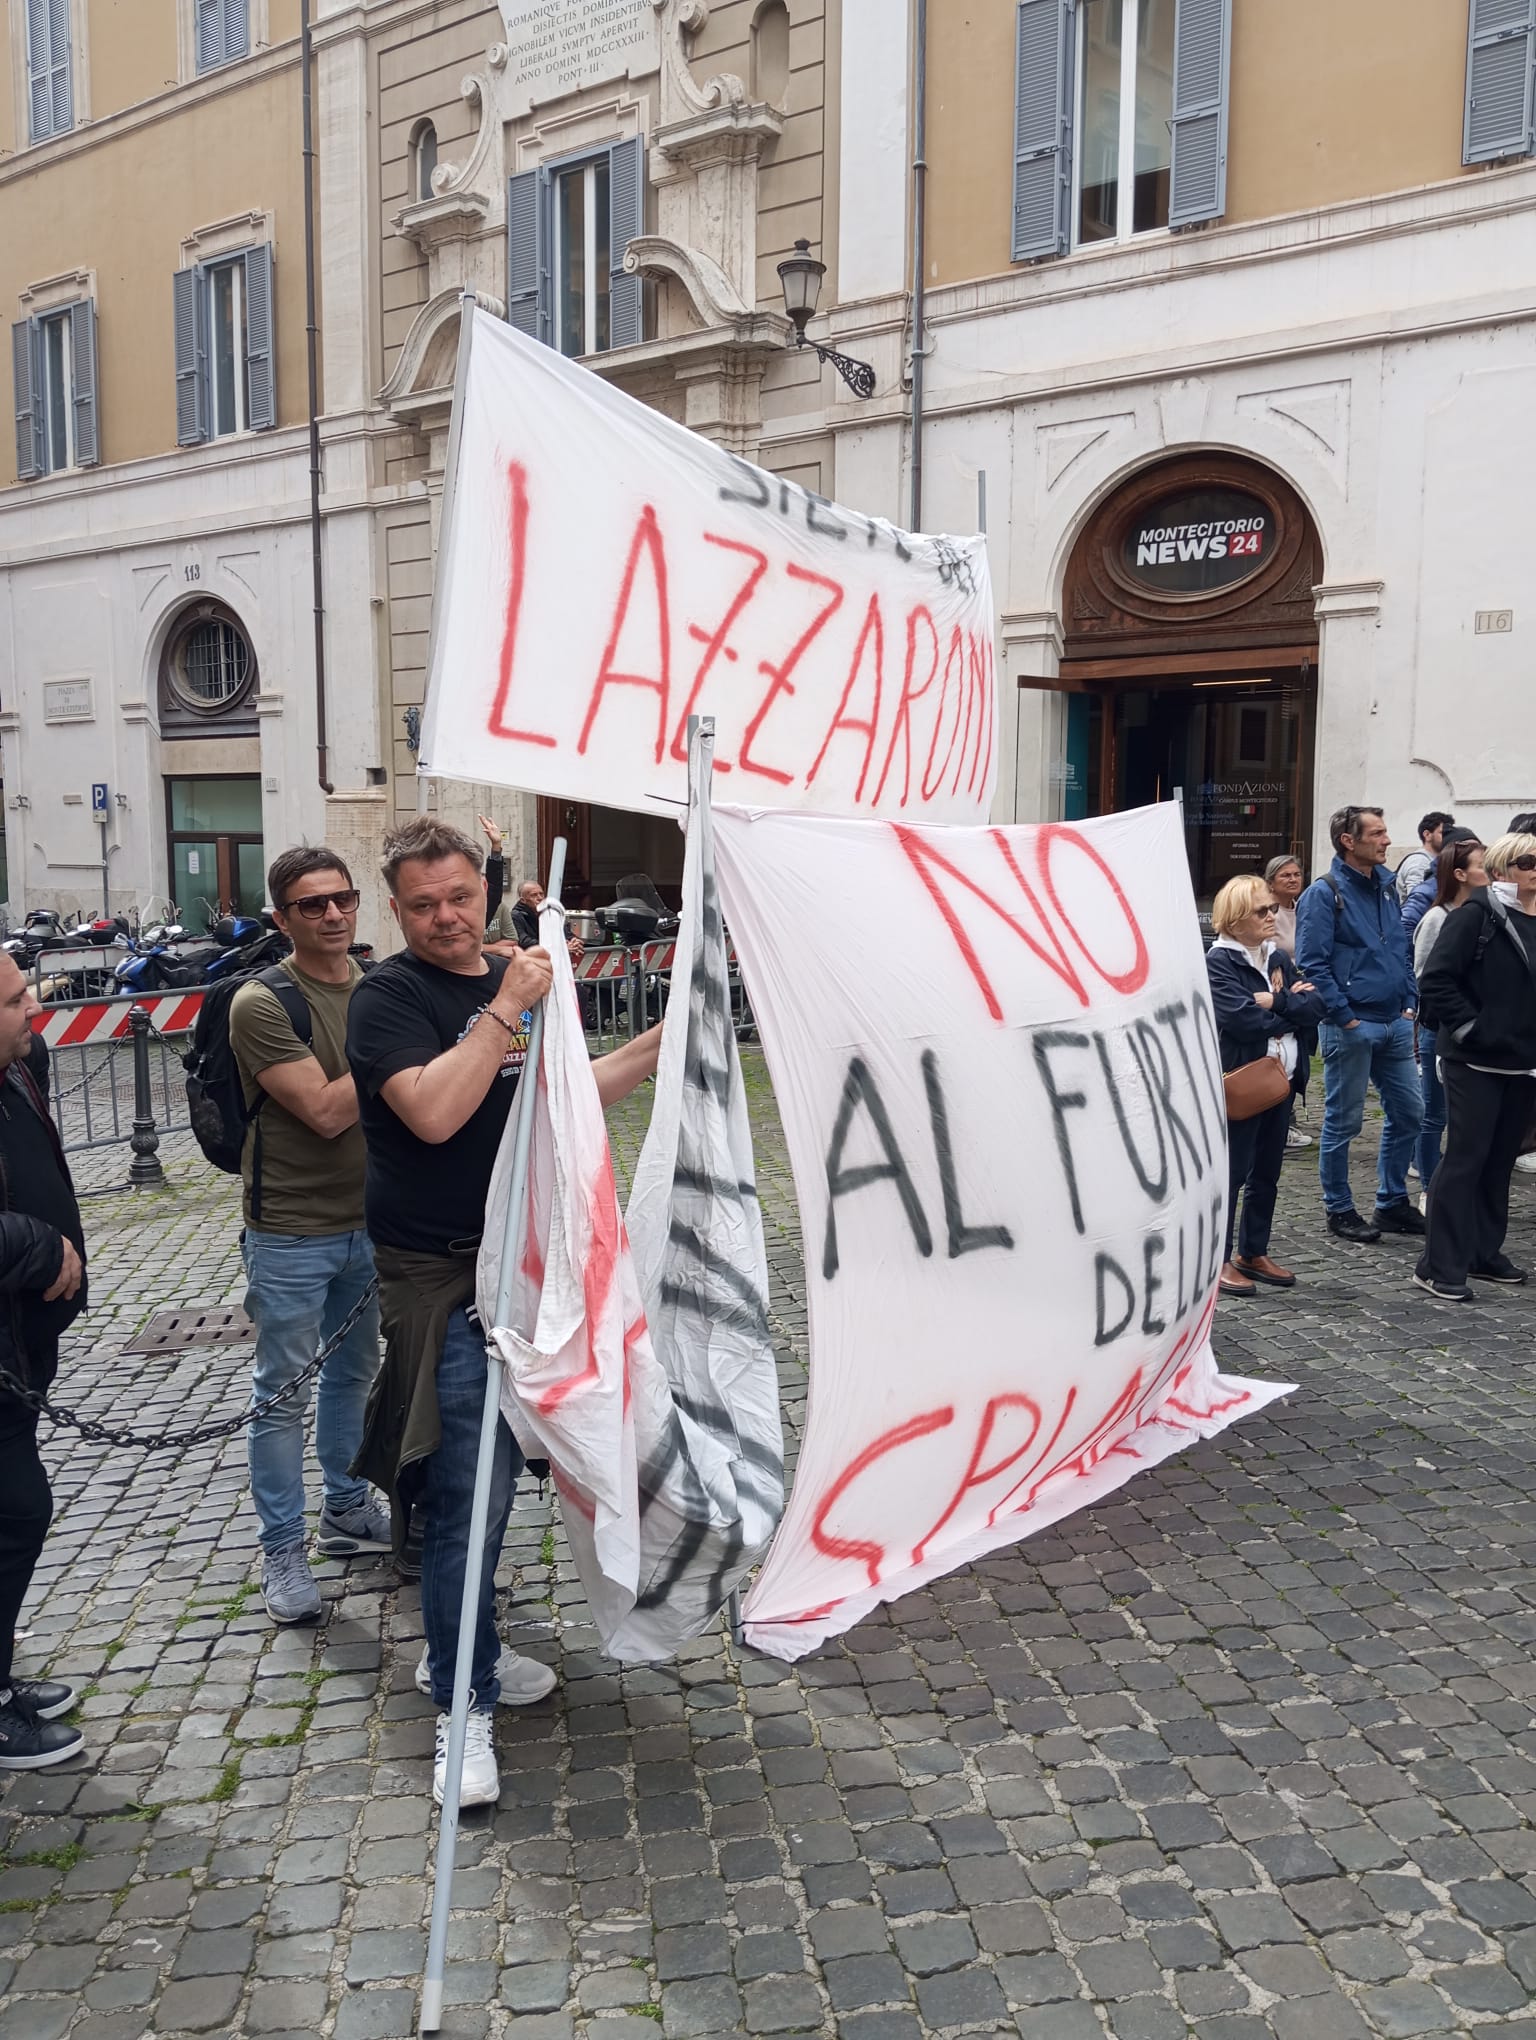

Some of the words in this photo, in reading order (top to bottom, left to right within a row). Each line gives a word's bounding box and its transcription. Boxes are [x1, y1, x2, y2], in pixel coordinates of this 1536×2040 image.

[508, 33, 555, 58] IGNOBILEM
[559, 22, 586, 38] VICVM
[520, 47, 557, 68] LIBERALI
[600, 17, 639, 40] APERVIT
[515, 67, 541, 85] ANNO
[545, 53, 581, 74] DOMINI
[1139, 517, 1265, 543] MONTECITORIO
[1137, 535, 1228, 566] NEWS
[1232, 534, 1258, 554] 24
[184, 564, 200, 582] 113
[488, 460, 992, 808] LAZZARONI
[1477, 612, 1510, 631] 116
[94, 786, 104, 808] P
[1213, 781, 1286, 796] FONDAZIONE
[889, 824, 1150, 1021] NO
[823, 1049, 1015, 1280] AL
[1032, 988, 1226, 1235] FURTO
[1094, 1196, 1222, 1346] DELLE
